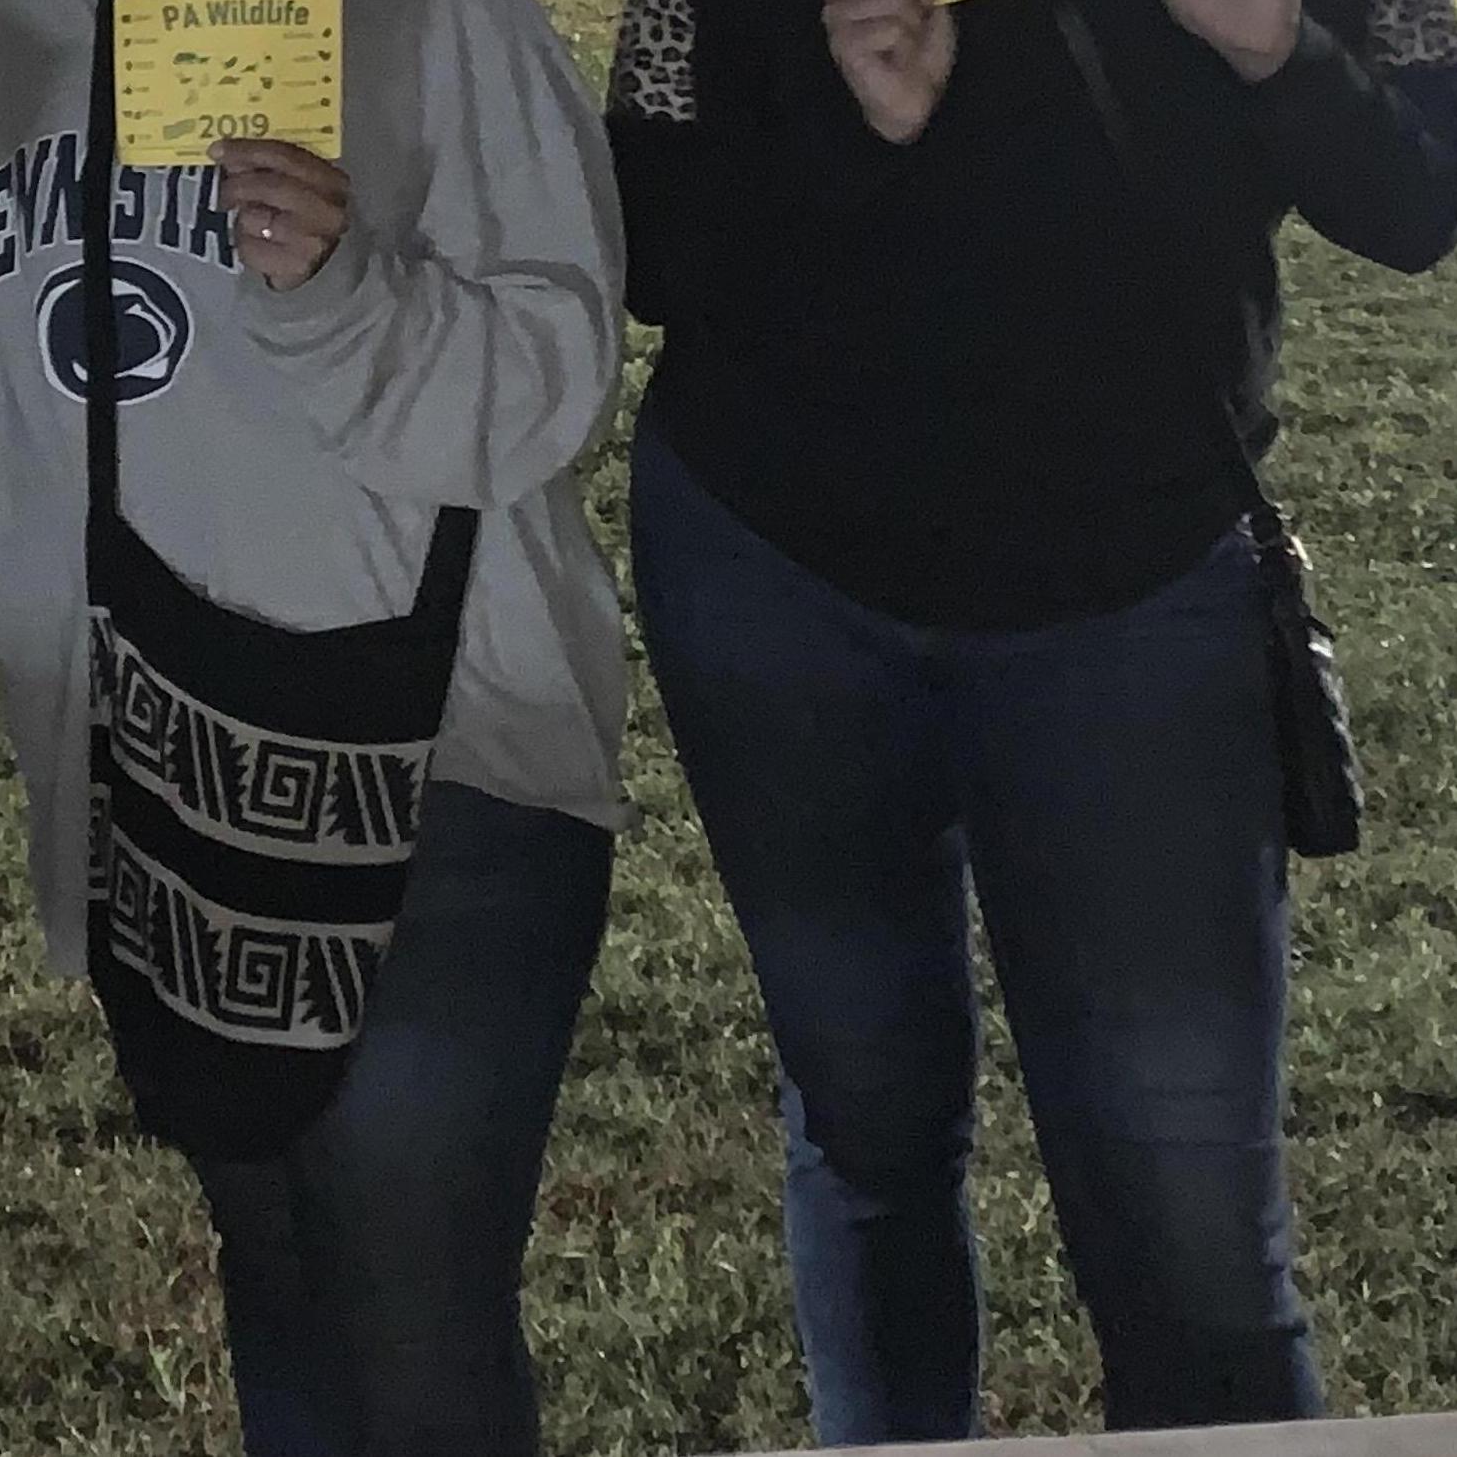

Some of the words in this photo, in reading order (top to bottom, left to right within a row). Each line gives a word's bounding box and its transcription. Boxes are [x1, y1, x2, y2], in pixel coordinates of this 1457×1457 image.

[162, 2, 201, 31] PA
[206, 0, 310, 28] Wildlife
[198, 113, 270, 140] 2019
